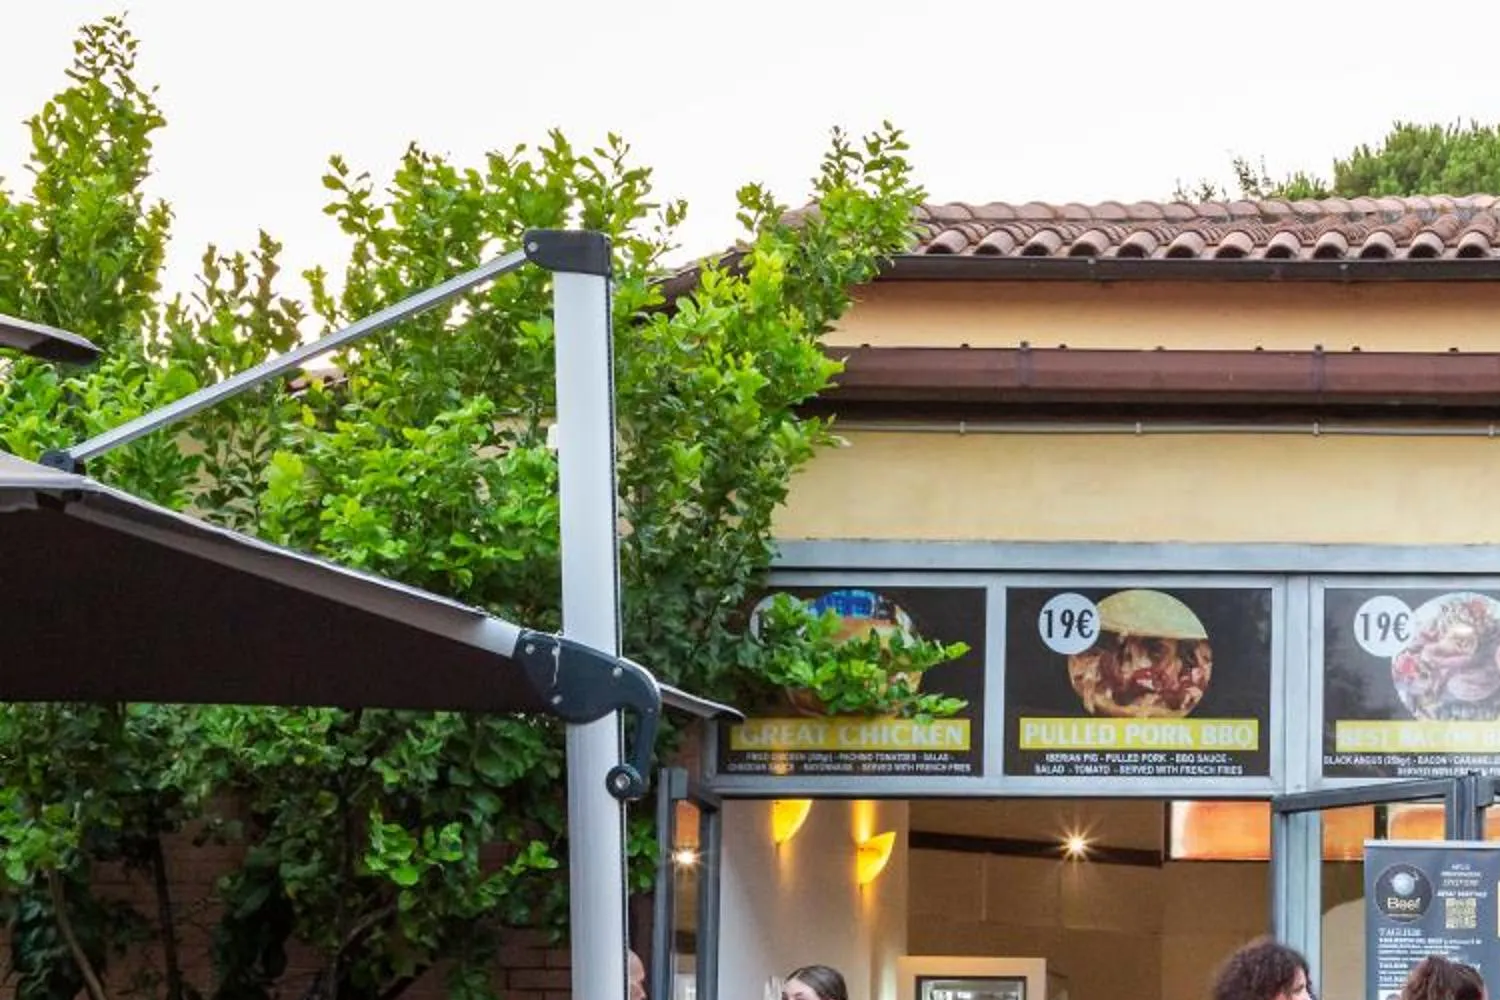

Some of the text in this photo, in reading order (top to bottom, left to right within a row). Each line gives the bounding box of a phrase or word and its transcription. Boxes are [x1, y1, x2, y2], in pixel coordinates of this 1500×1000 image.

[1042, 607, 1095, 641] 19€
[1359, 609, 1411, 644] 19€
[739, 723, 963, 746] GREAT CHICKEN
[1024, 722, 1254, 746] PULLED PORK BBQ
[1105, 753, 1139, 763] PULLED
[1141, 753, 1167, 763] PORK
[1035, 765, 1243, 775] SALAD TOMATO SERVED WITH FRENCH FRIES
[1386, 897, 1421, 911] Beef
